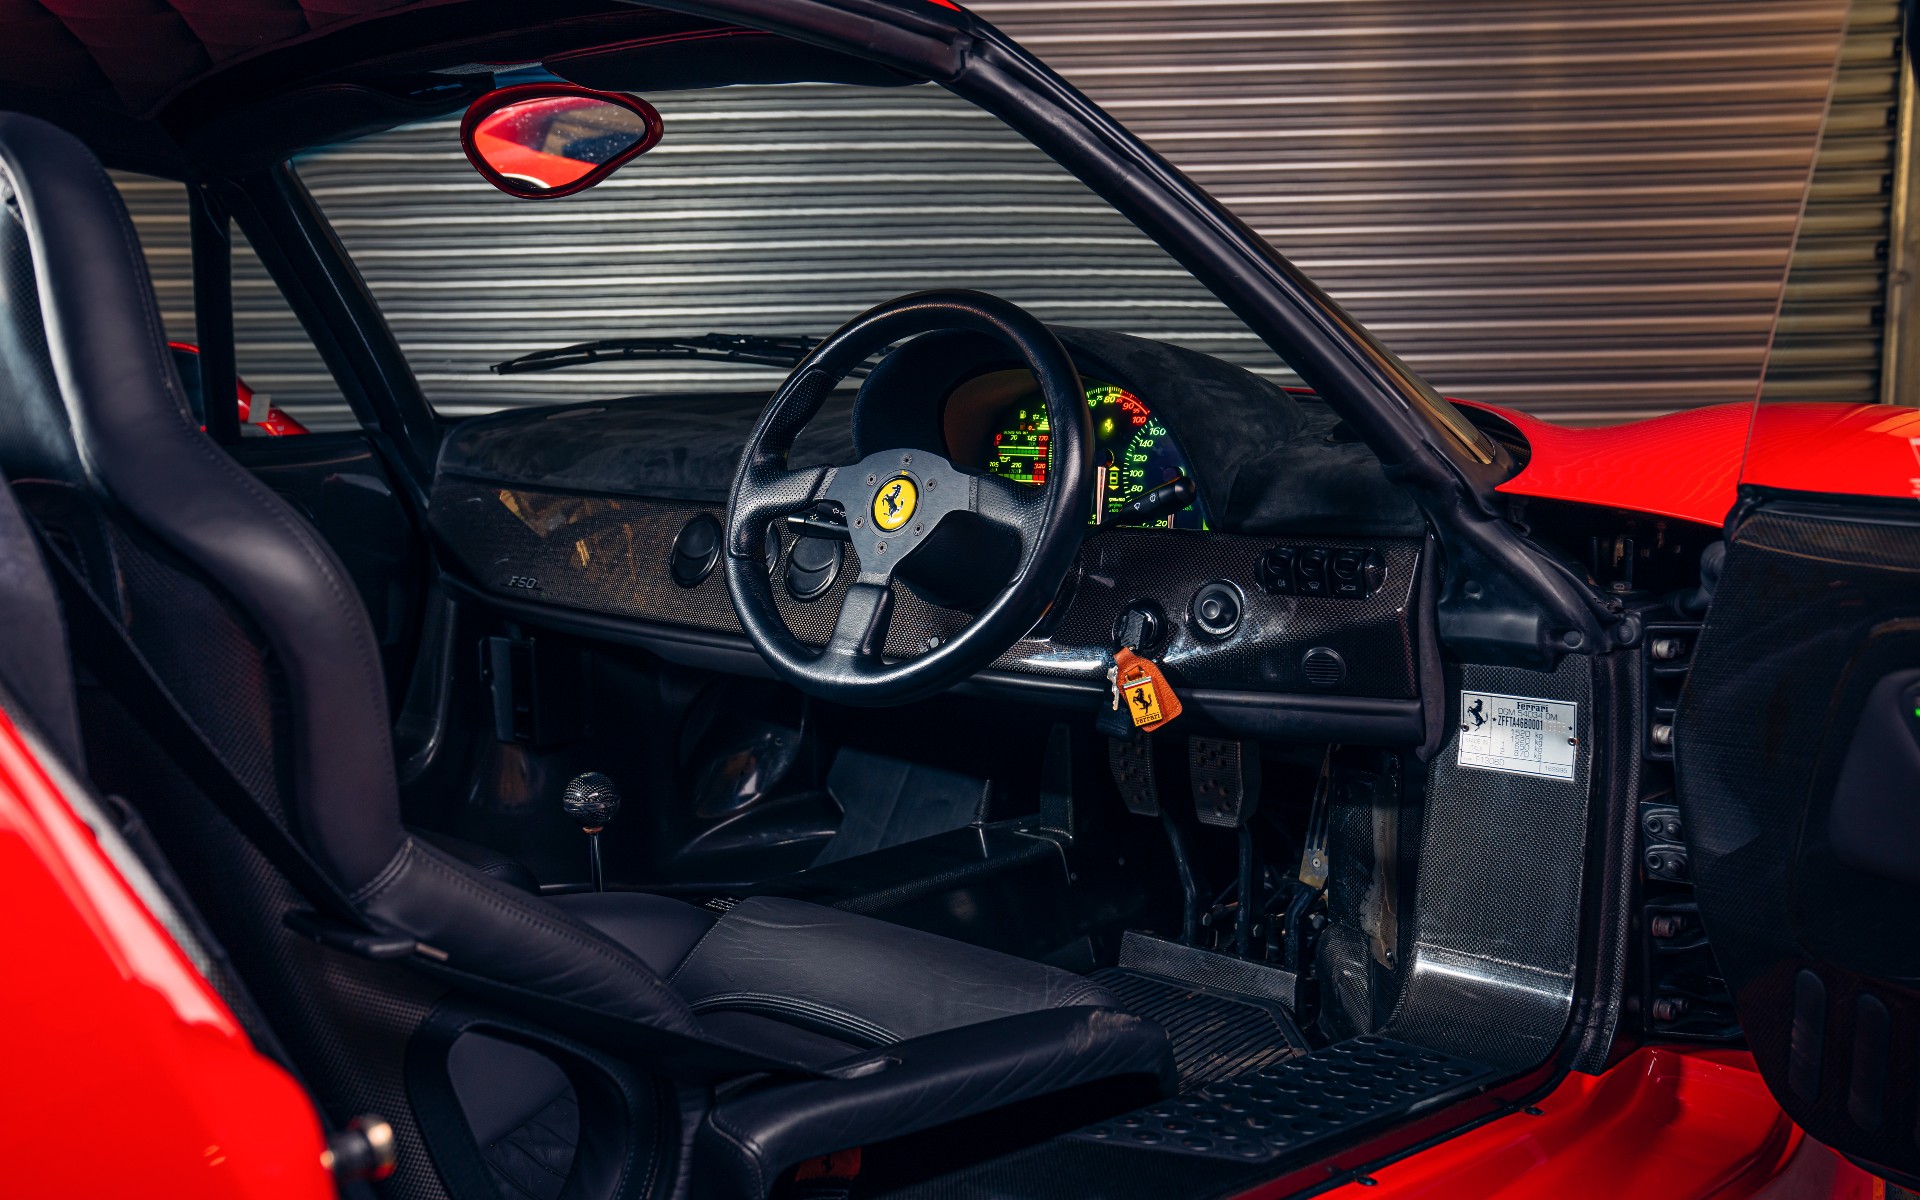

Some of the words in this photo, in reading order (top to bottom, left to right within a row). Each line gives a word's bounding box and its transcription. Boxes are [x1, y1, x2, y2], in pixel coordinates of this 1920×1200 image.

[1122, 402, 1134, 410] 90
[1150, 427, 1166, 436] 160
[508, 576, 537, 589] F50
[1516, 702, 1548, 712] Ferrari
[1135, 712, 1161, 724] Ferrari
